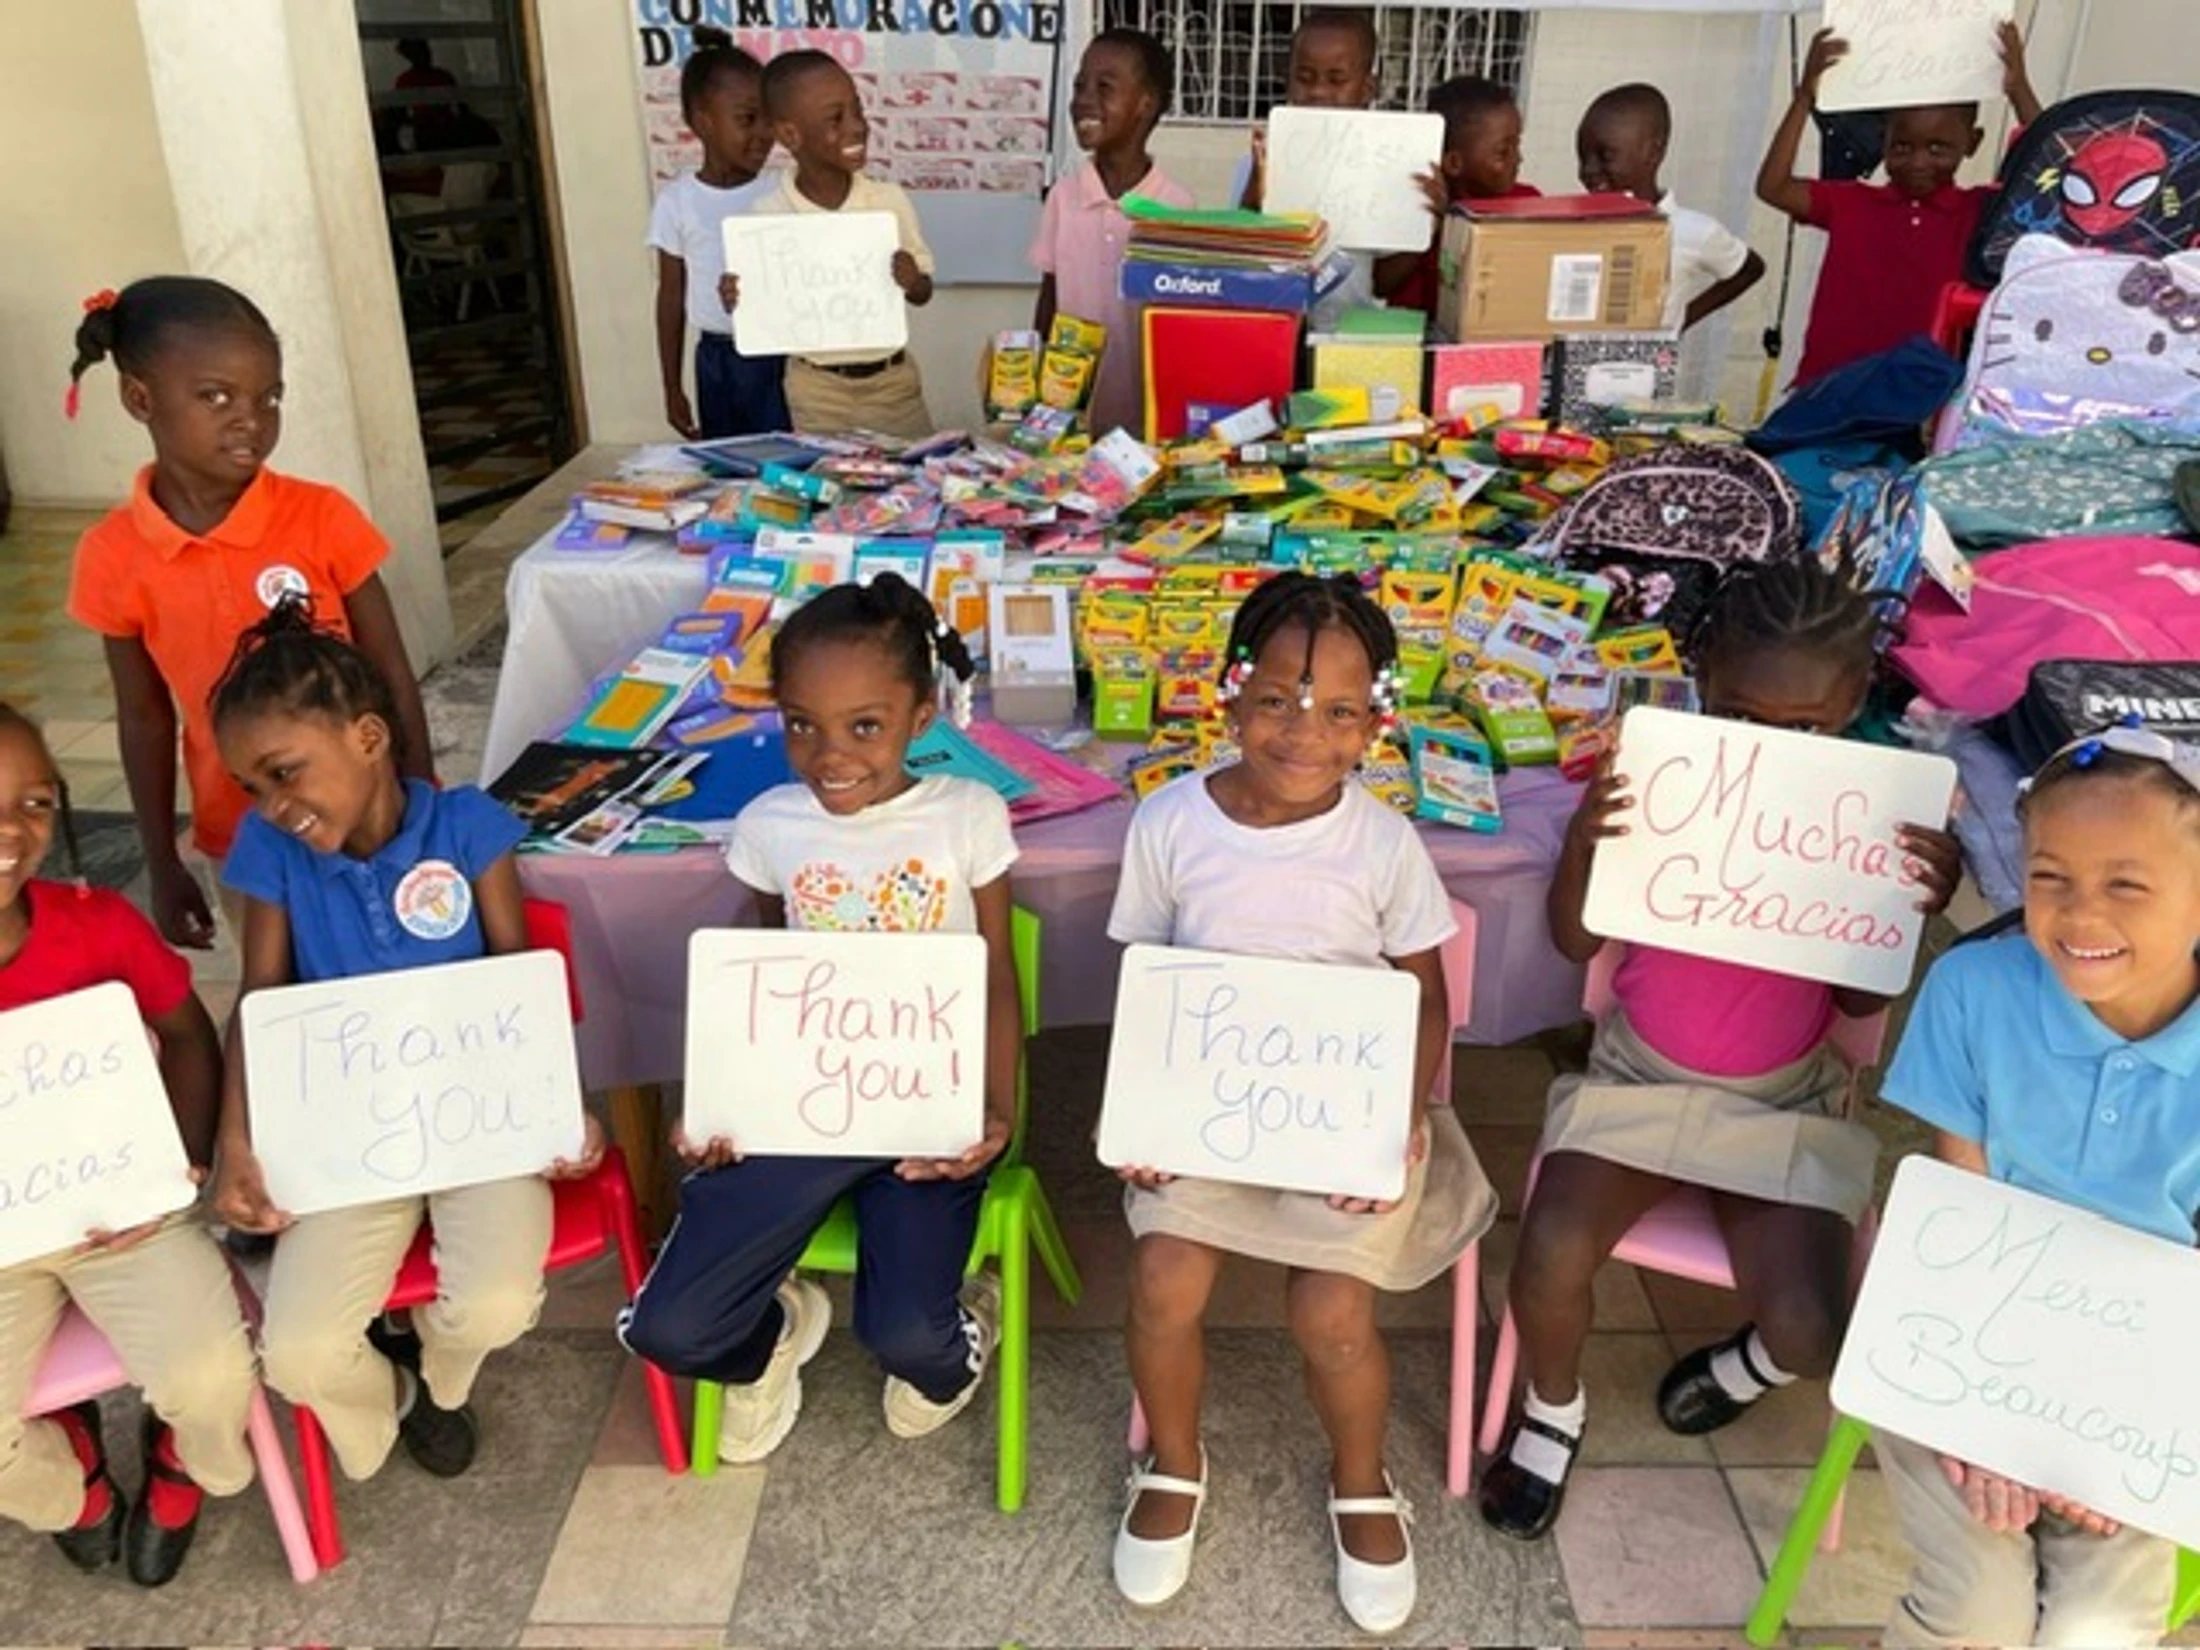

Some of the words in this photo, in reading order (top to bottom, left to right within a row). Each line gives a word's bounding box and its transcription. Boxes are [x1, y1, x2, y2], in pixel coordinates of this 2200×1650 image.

[738, 223, 874, 296] Thank
[1154, 274, 1222, 296] Oxford
[1646, 853, 1904, 949] Gracias
[723, 955, 961, 1045] Thank
[1145, 962, 1384, 1068] Thank
[259, 999, 527, 1104] Thank
[1914, 1203, 2147, 1367] Merci
[1867, 1311, 2200, 1503] Beaucoup
